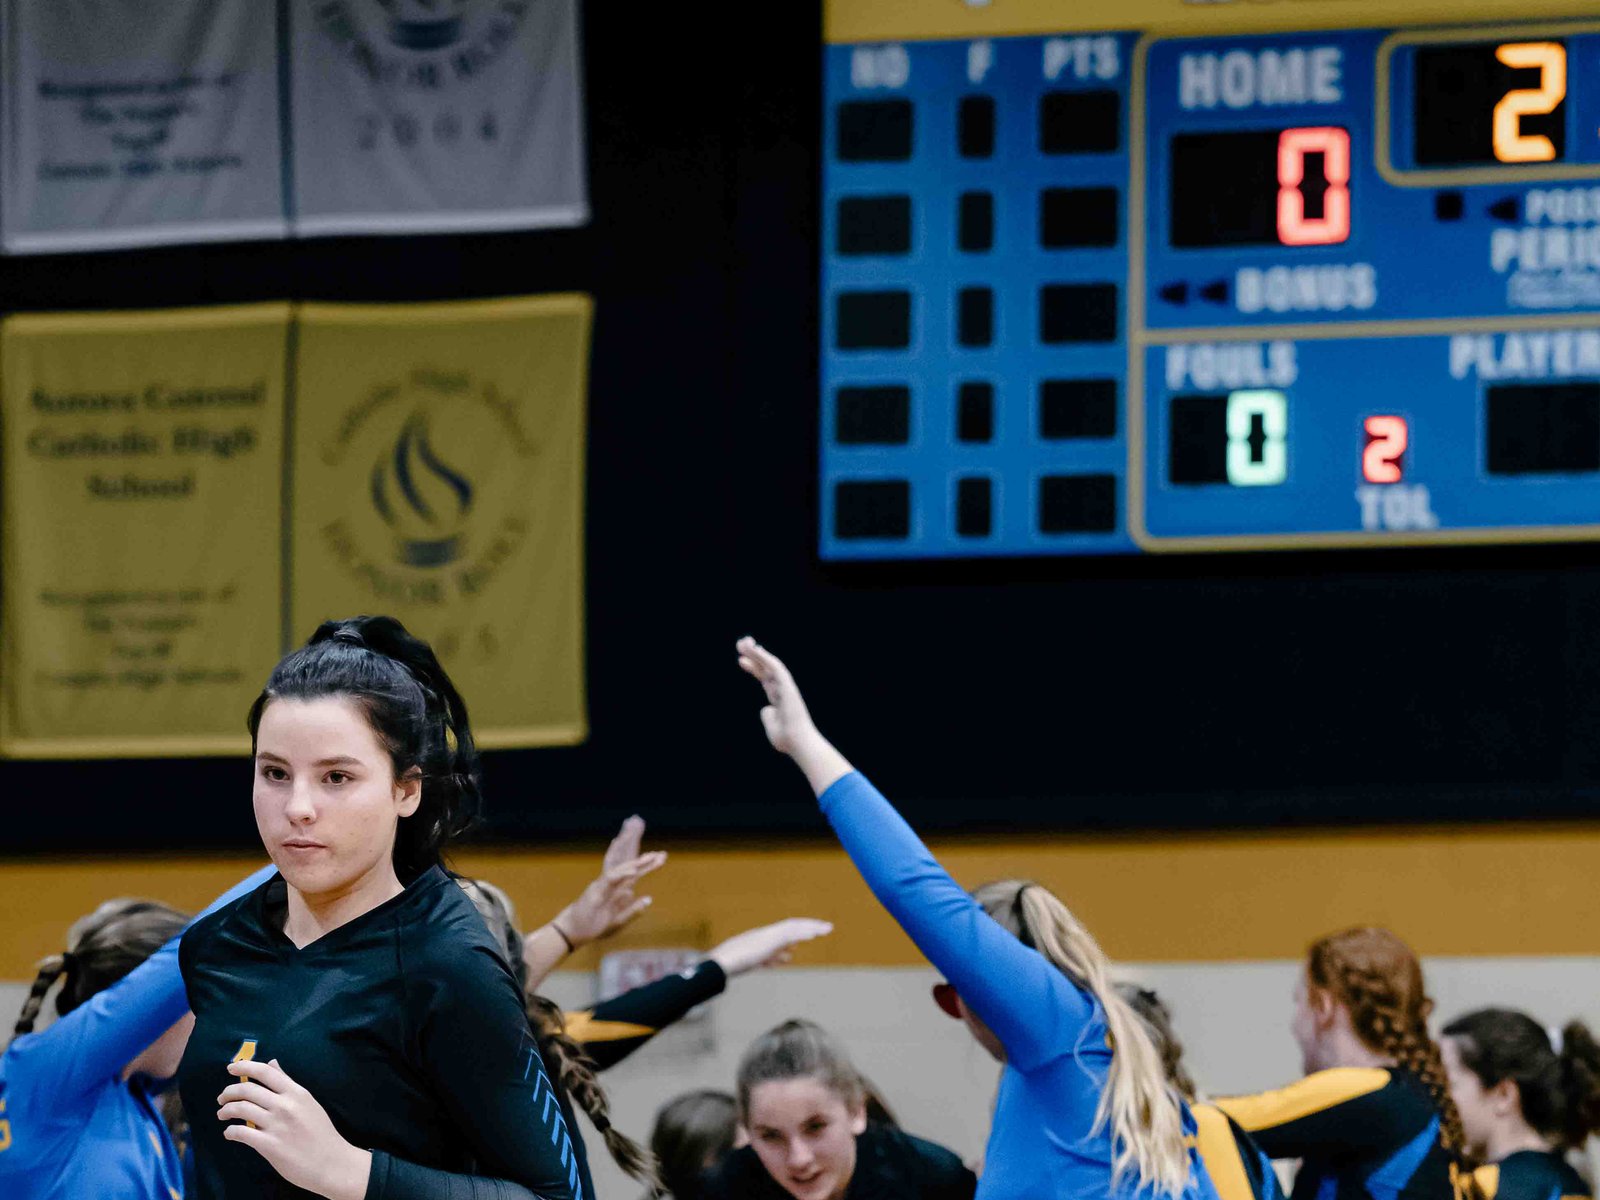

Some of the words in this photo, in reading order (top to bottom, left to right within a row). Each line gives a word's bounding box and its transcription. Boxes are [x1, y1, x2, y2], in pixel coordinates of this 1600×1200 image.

[968, 41, 992, 84] F
[1043, 37, 1119, 81] PTS
[1179, 48, 1342, 109] HOME
[1492, 41, 1567, 163] 2
[1277, 126, 1350, 246] 0
[1235, 263, 1376, 313] BONUS
[1165, 340, 1298, 391] FOULS
[1226, 388, 1287, 487] 0
[1362, 415, 1408, 483] 2
[1355, 485, 1438, 530] TOL
